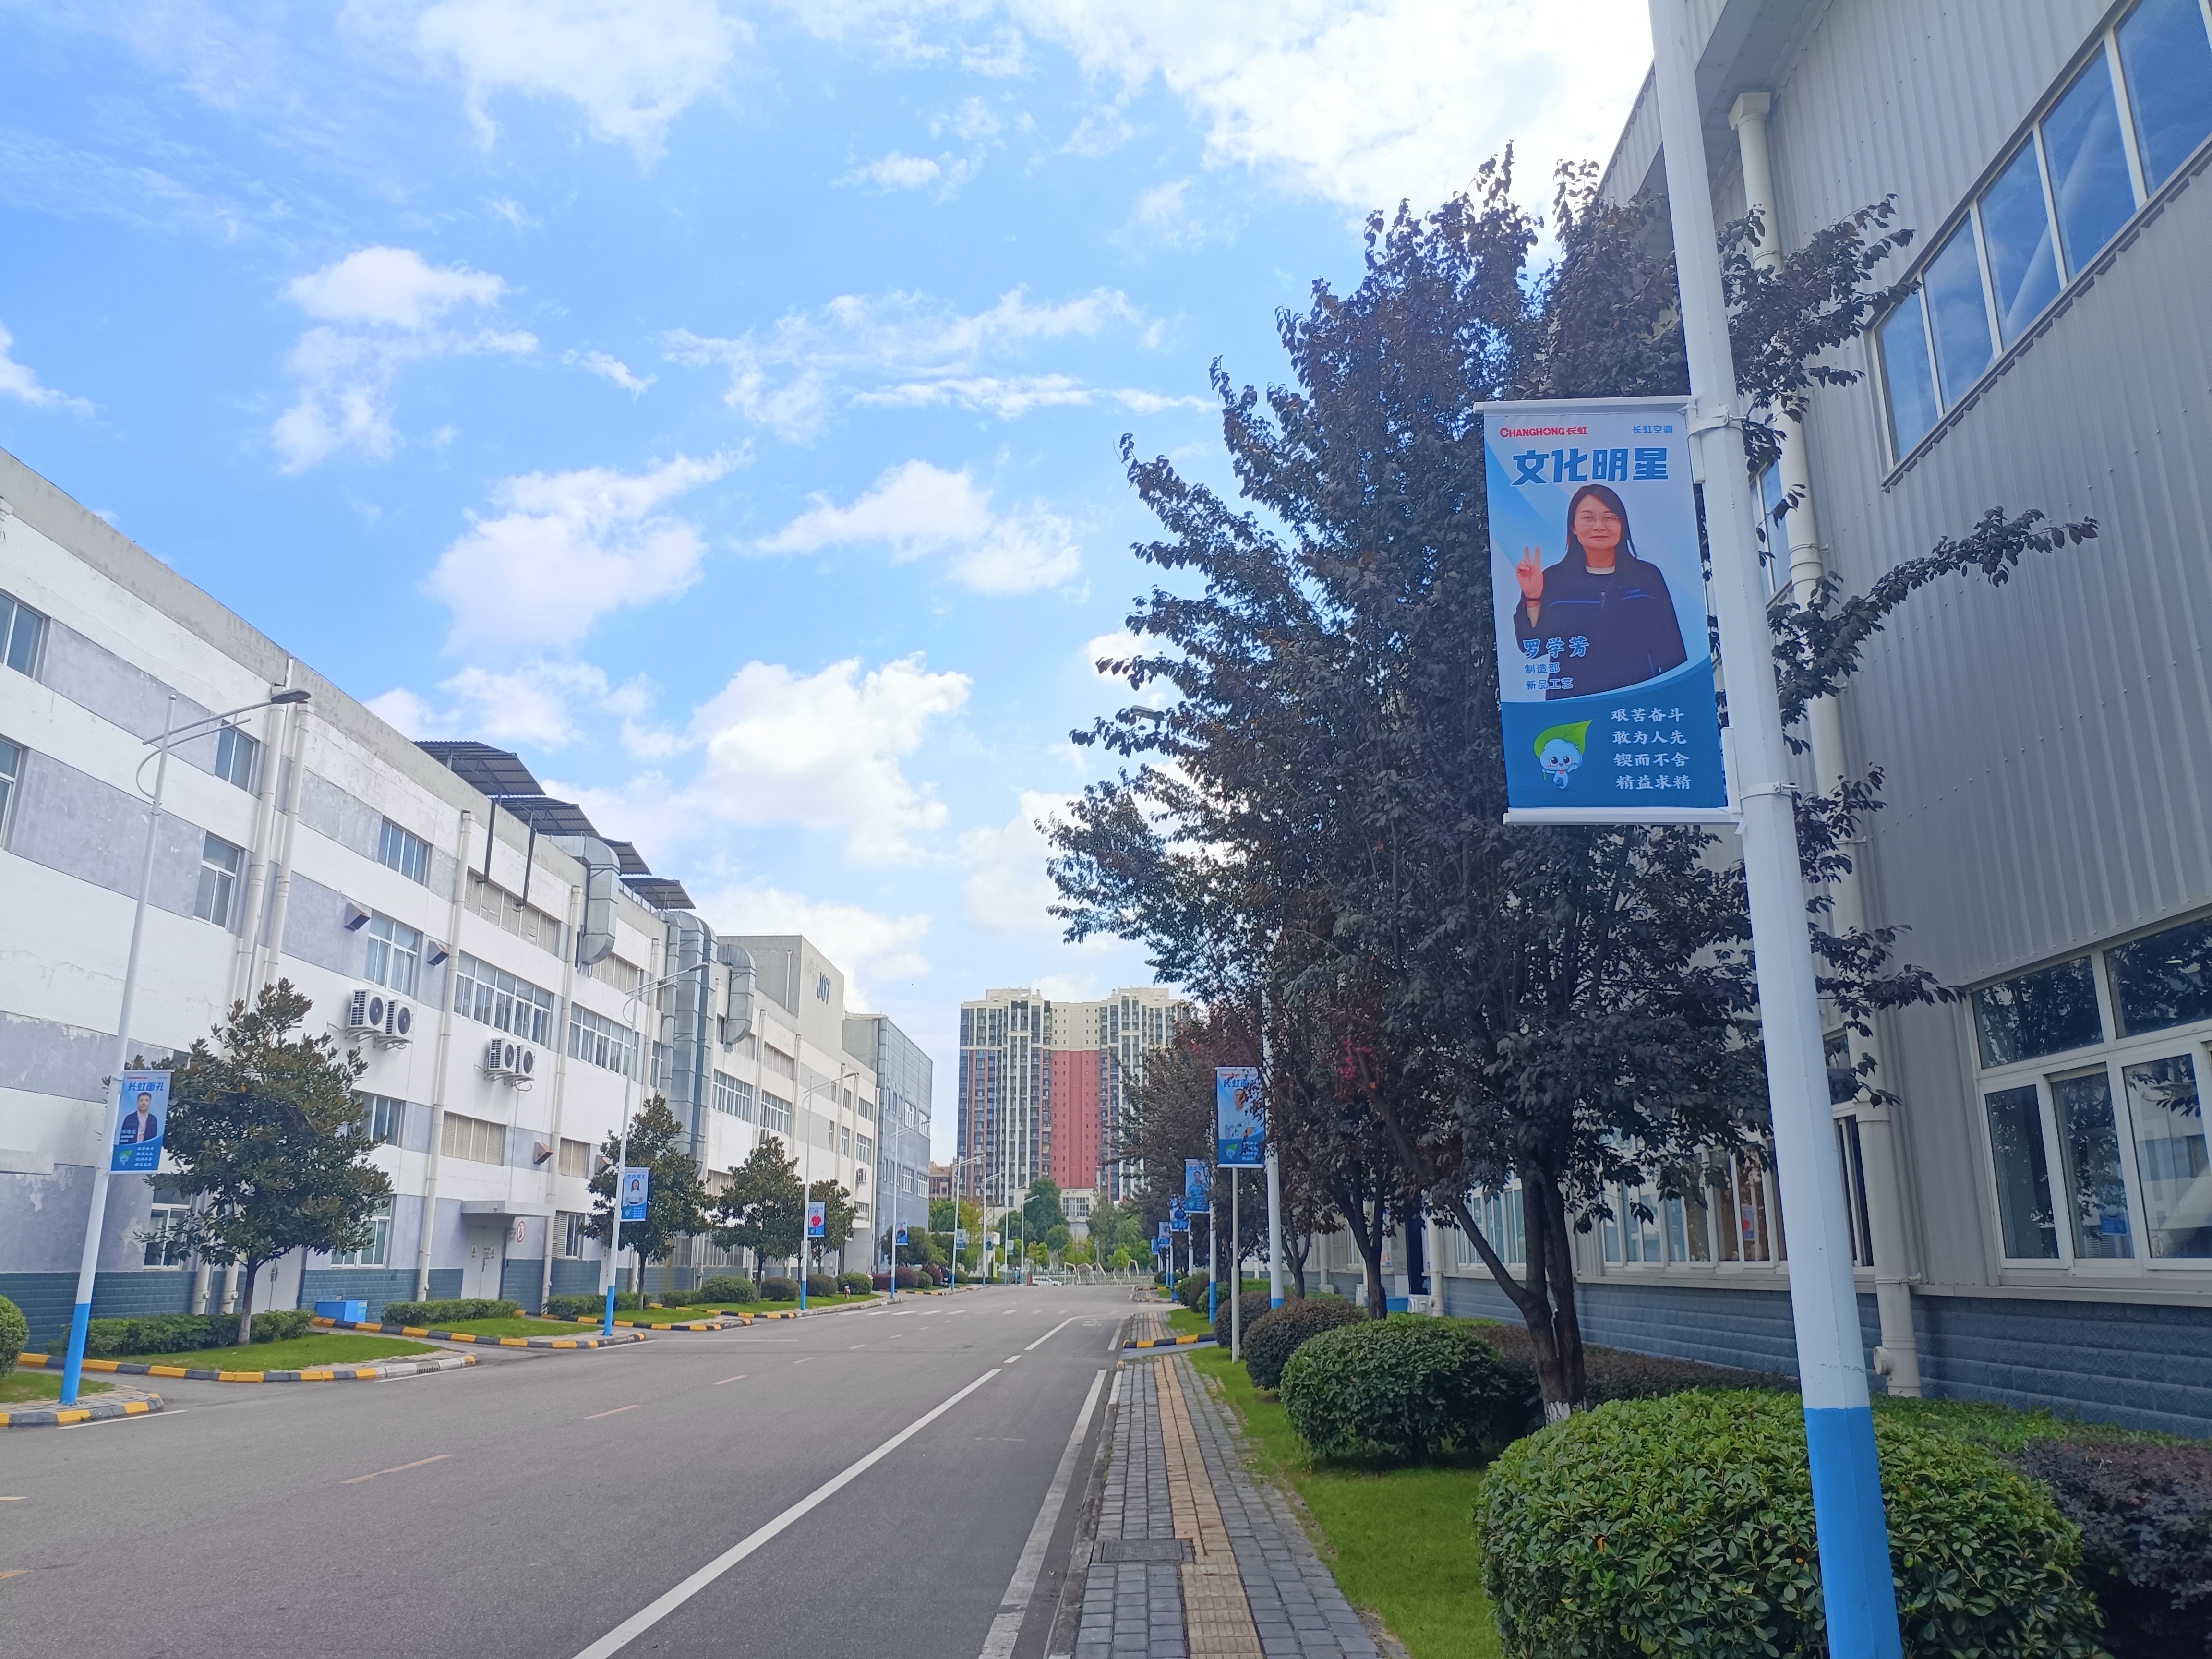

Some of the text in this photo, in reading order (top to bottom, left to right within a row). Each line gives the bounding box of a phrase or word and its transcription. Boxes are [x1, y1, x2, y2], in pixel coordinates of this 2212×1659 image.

[1500, 426, 1587, 437] CHANGHONG 长虹
[1633, 425, 1673, 434] 长虹空调
[1510, 448, 1668, 485] 文化明星
[1523, 636, 1589, 659] 罗学芳
[1525, 662, 1560, 674] 制造部
[1526, 677, 1573, 690] 新品工艺
[1610, 707, 1684, 722] 艰苦奋斗
[1612, 730, 1687, 745] 敢为人先
[1613, 752, 1689, 767] 锲而不舍
[1616, 774, 1691, 790] 精益求精
[817, 971, 830, 1005] J07
[128, 1082, 164, 1091] 长虹面孔
